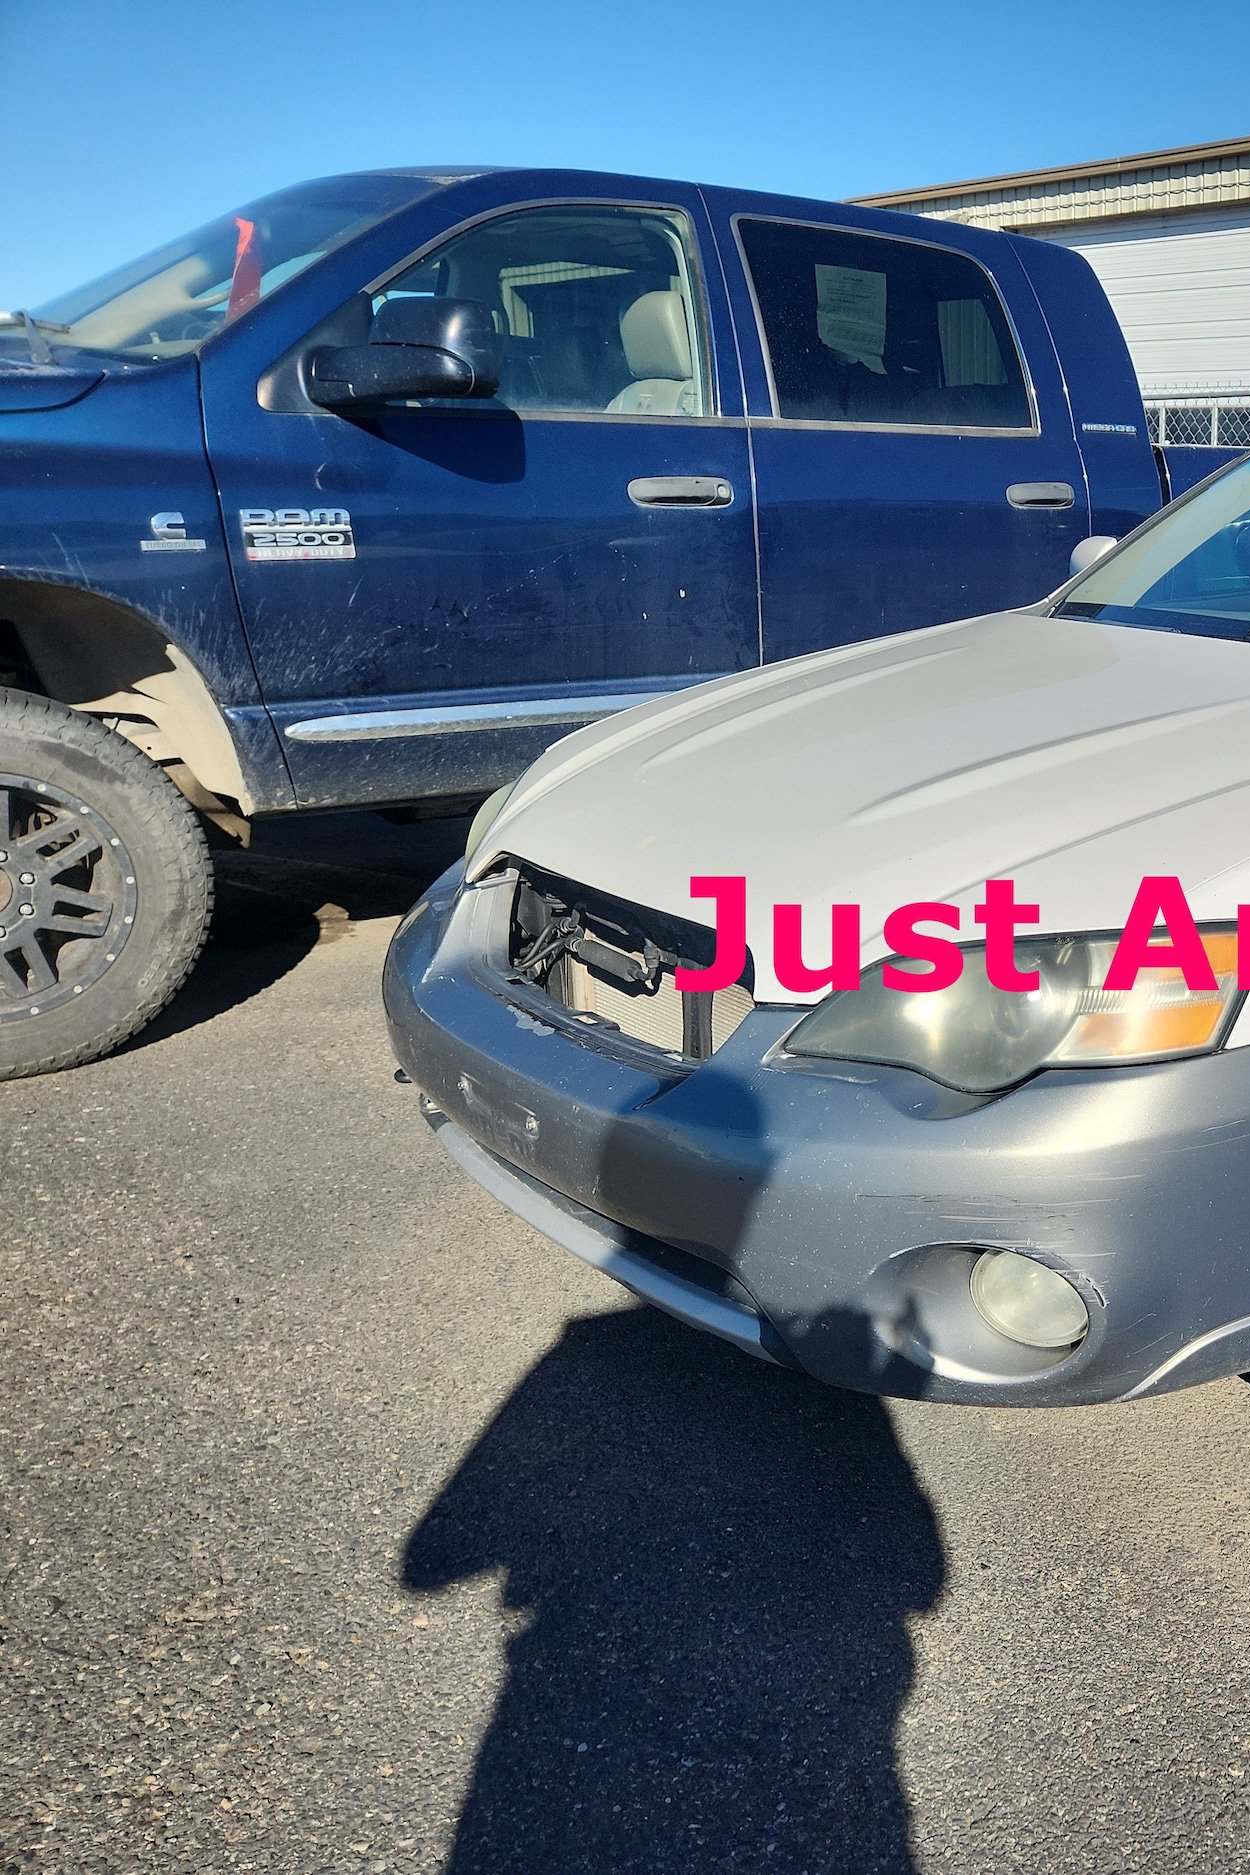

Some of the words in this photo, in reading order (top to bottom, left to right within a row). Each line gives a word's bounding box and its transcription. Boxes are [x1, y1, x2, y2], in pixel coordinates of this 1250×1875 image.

[239, 508, 351, 527] RAM
[252, 532, 345, 547] 2500
[311, 547, 345, 556] DUTY
